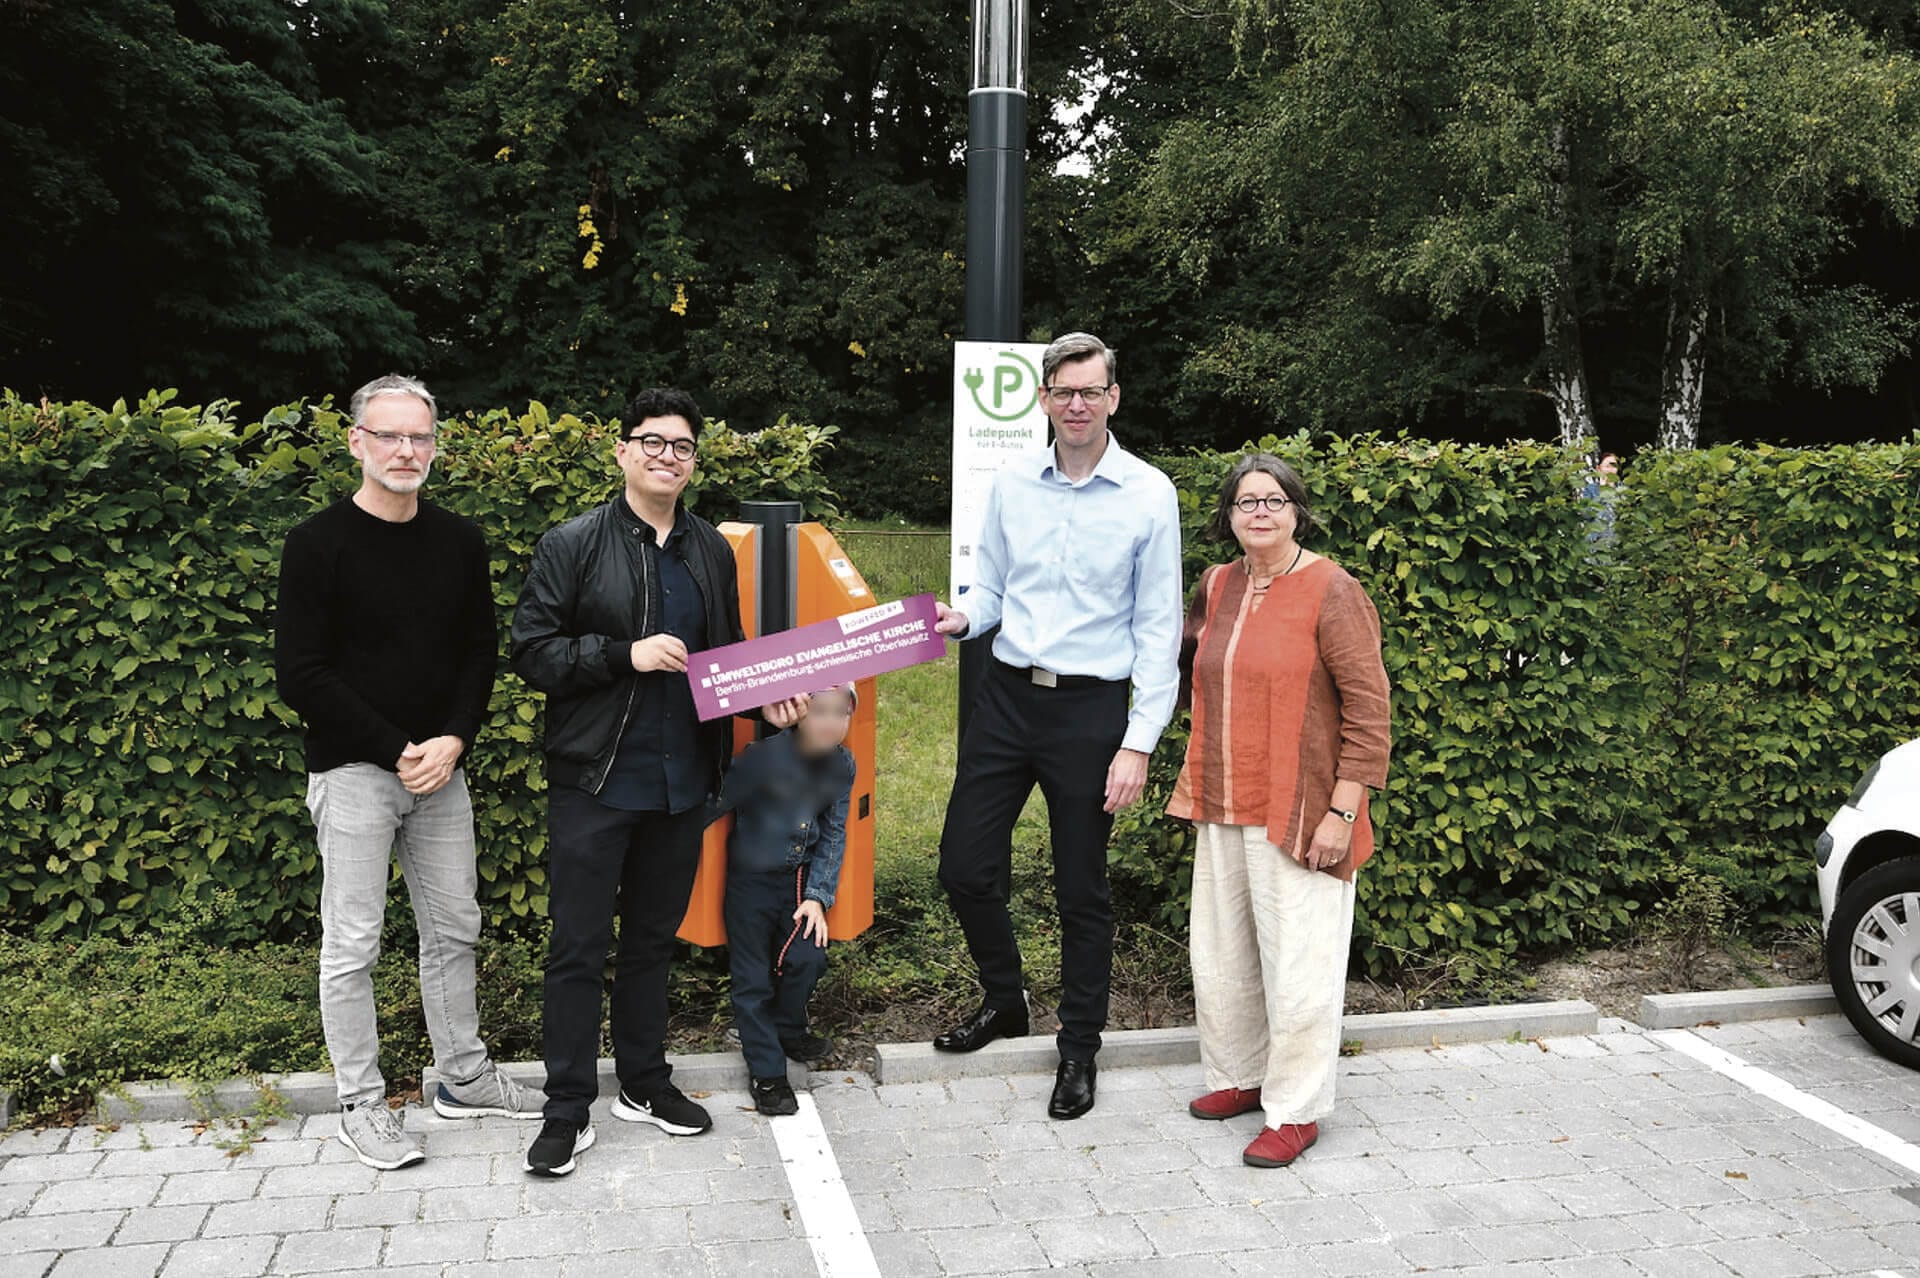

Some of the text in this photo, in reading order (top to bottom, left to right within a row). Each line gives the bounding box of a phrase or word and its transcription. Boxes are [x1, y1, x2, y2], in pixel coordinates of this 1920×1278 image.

[993, 365, 1023, 408] P
[969, 426, 1033, 440] Ladepunkt
[795, 632, 882, 664] EVANGELISCHE
[883, 619, 927, 639] KIRCHE
[873, 632, 930, 654] Oberlausitz
